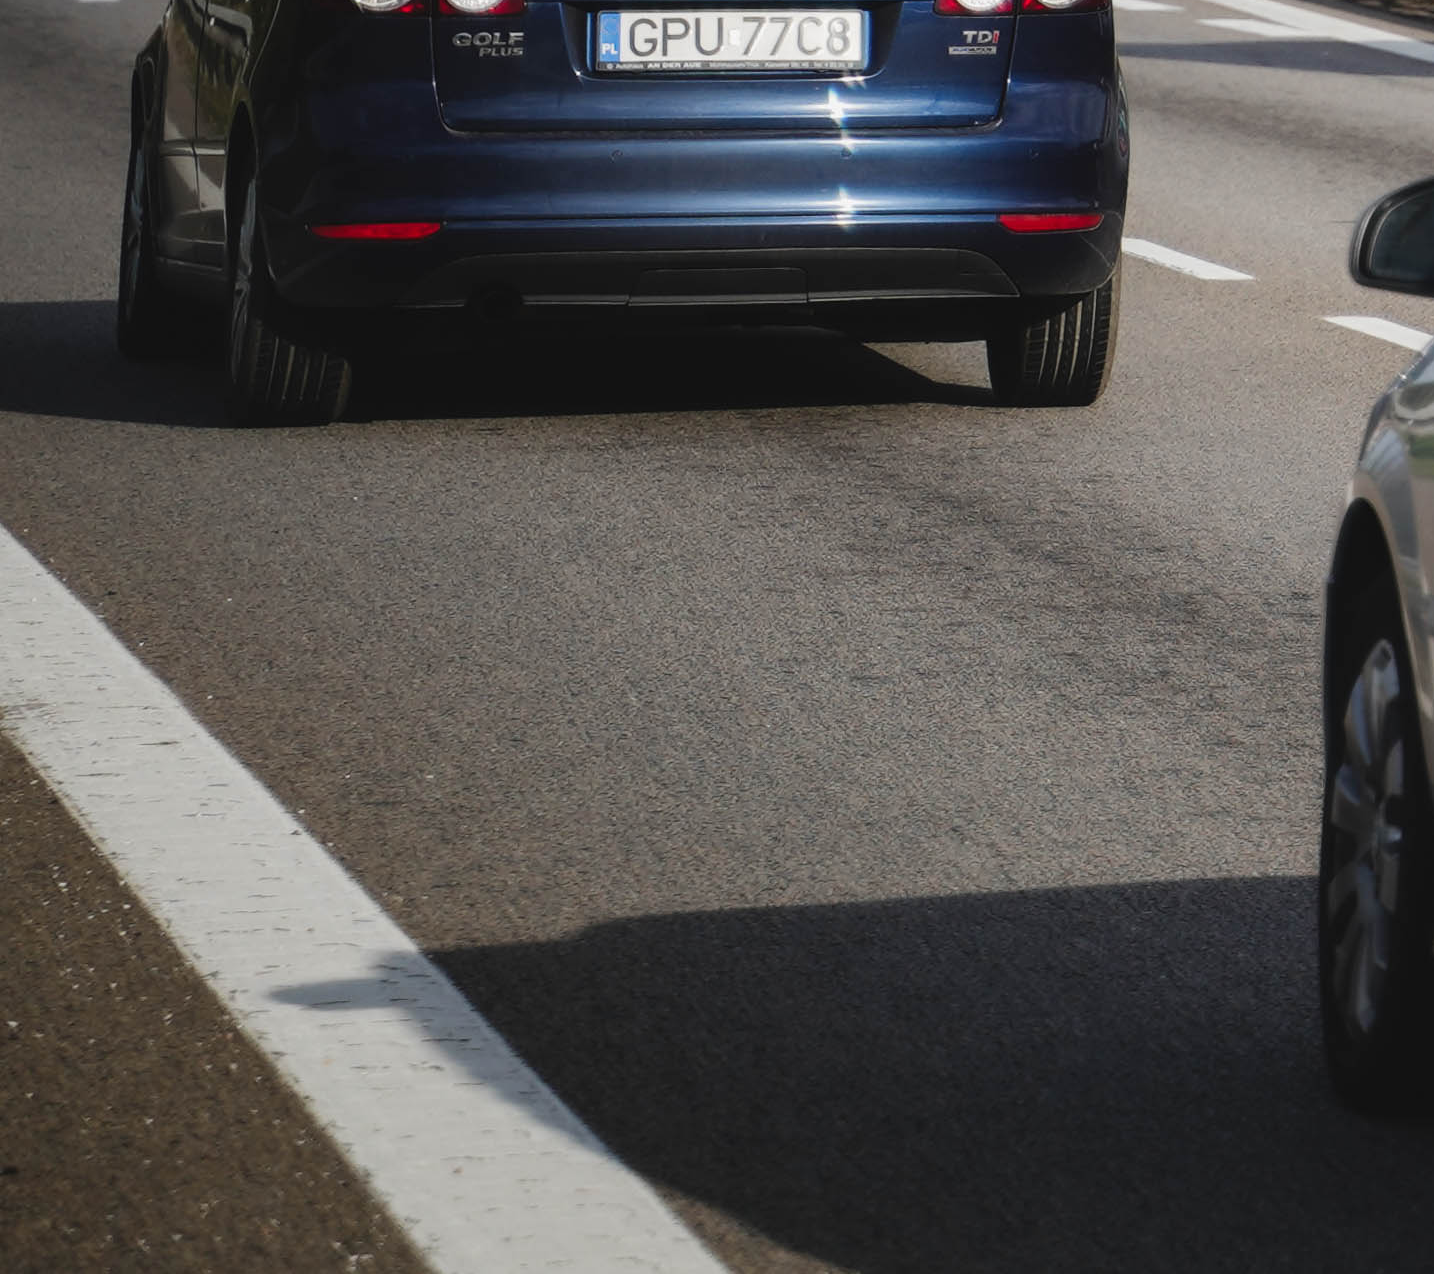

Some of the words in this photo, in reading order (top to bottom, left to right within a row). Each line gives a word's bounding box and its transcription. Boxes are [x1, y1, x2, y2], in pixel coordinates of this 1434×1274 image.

[452, 32, 524, 46] GOLF
[601, 43, 618, 55] PL
[629, 18, 724, 57] GPU
[742, 16, 850, 56] 77C8
[963, 30, 999, 43] TDI
[479, 47, 523, 57] PLUS
